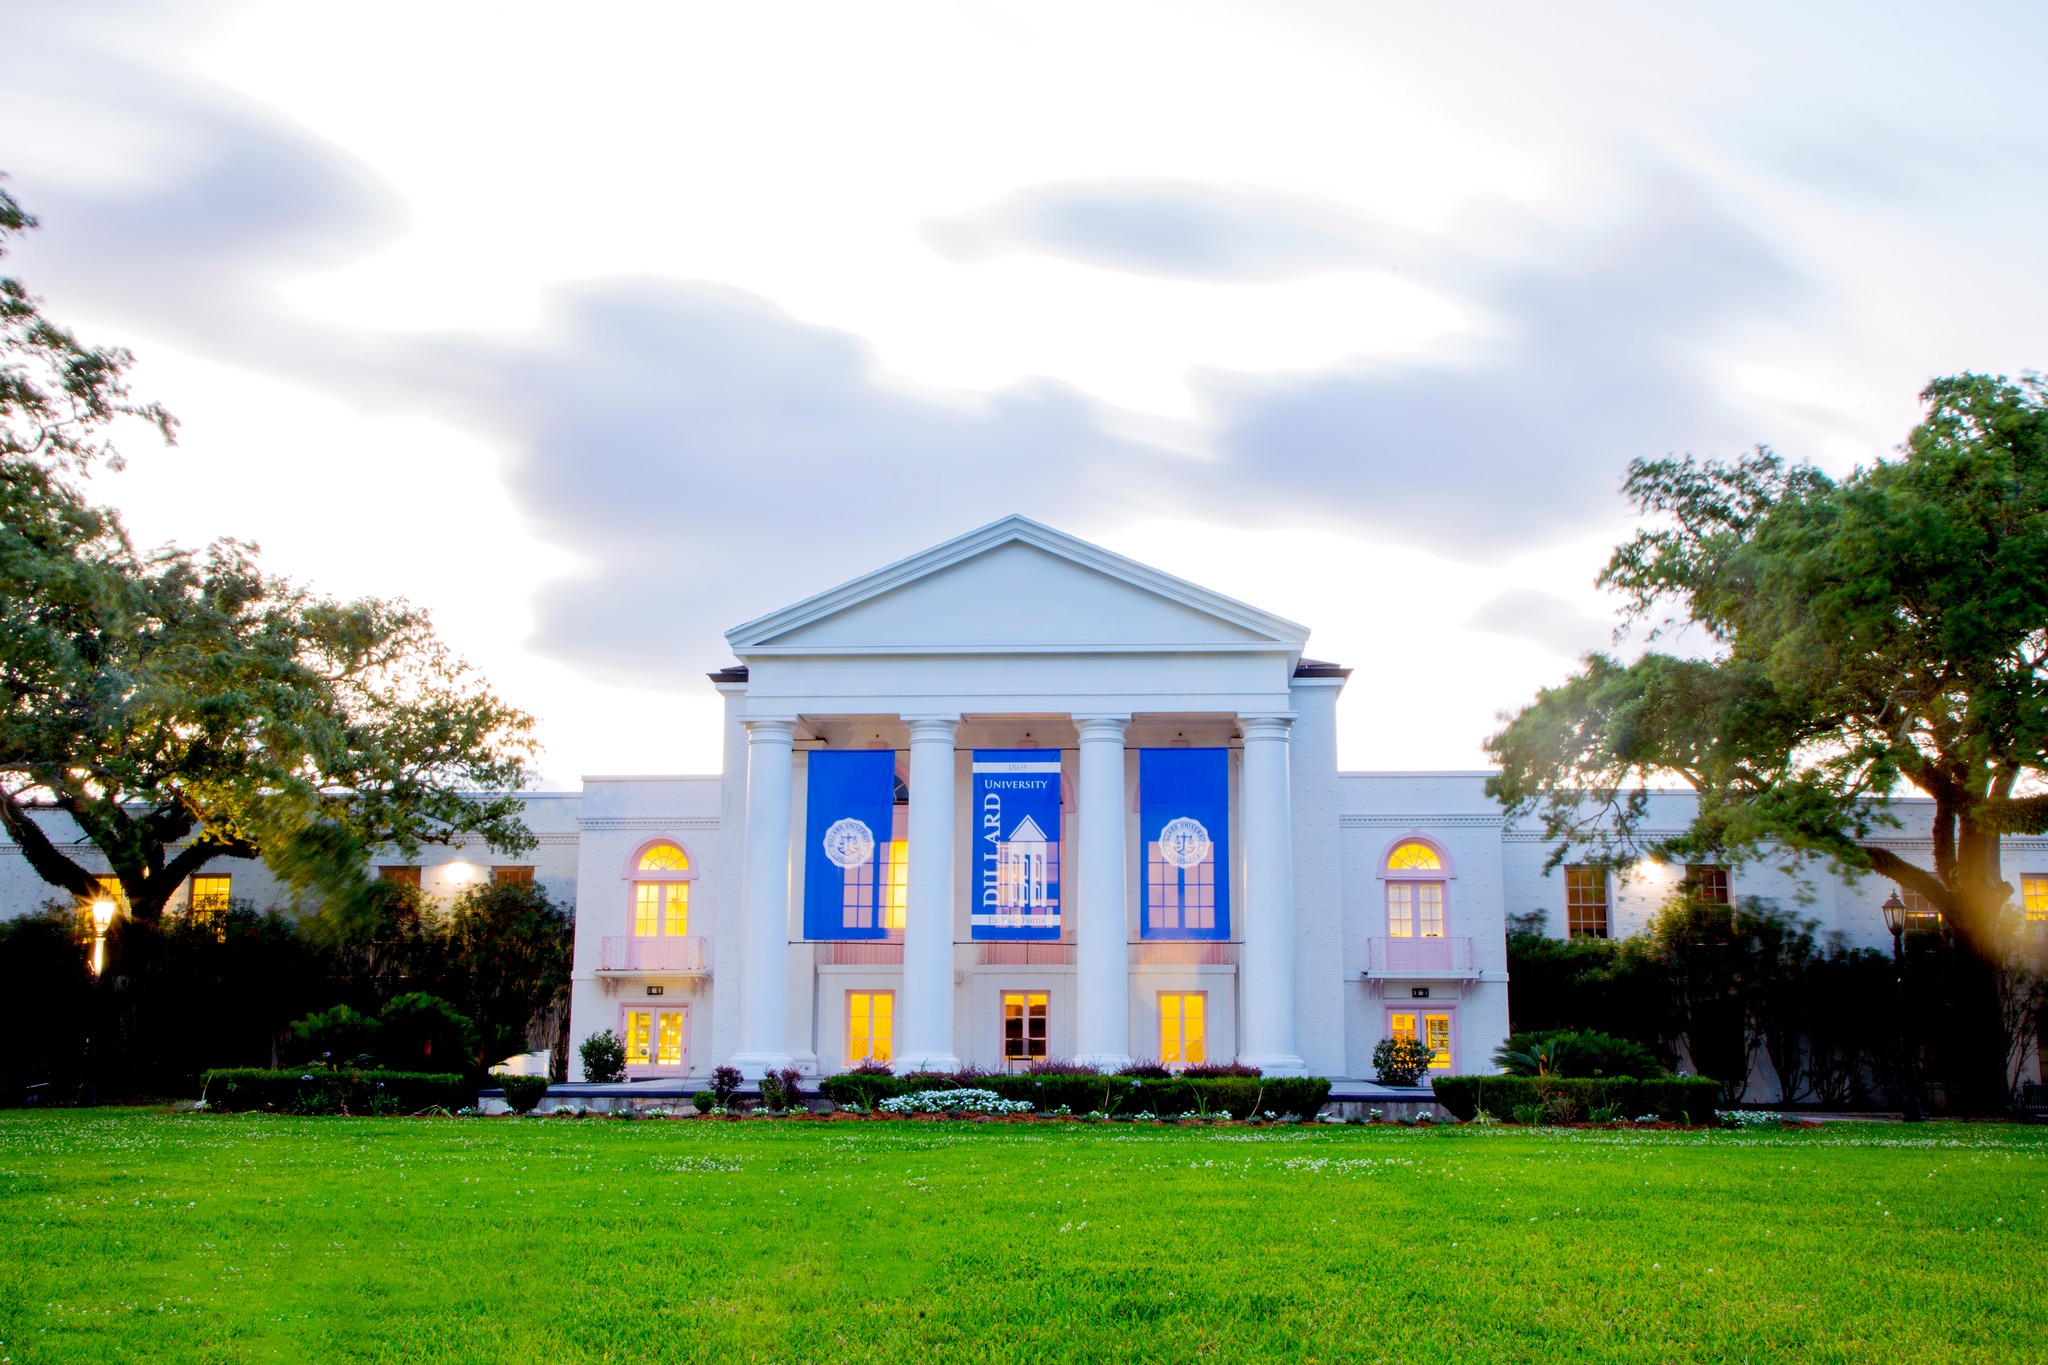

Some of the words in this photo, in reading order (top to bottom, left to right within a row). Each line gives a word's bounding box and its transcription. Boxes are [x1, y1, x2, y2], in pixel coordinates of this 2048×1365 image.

[1008, 763, 1026, 772] 1869
[984, 779, 1048, 789] UNIVERSITY
[983, 793, 1001, 907] DILLARD
[1022, 915, 1046, 924] Fortis
